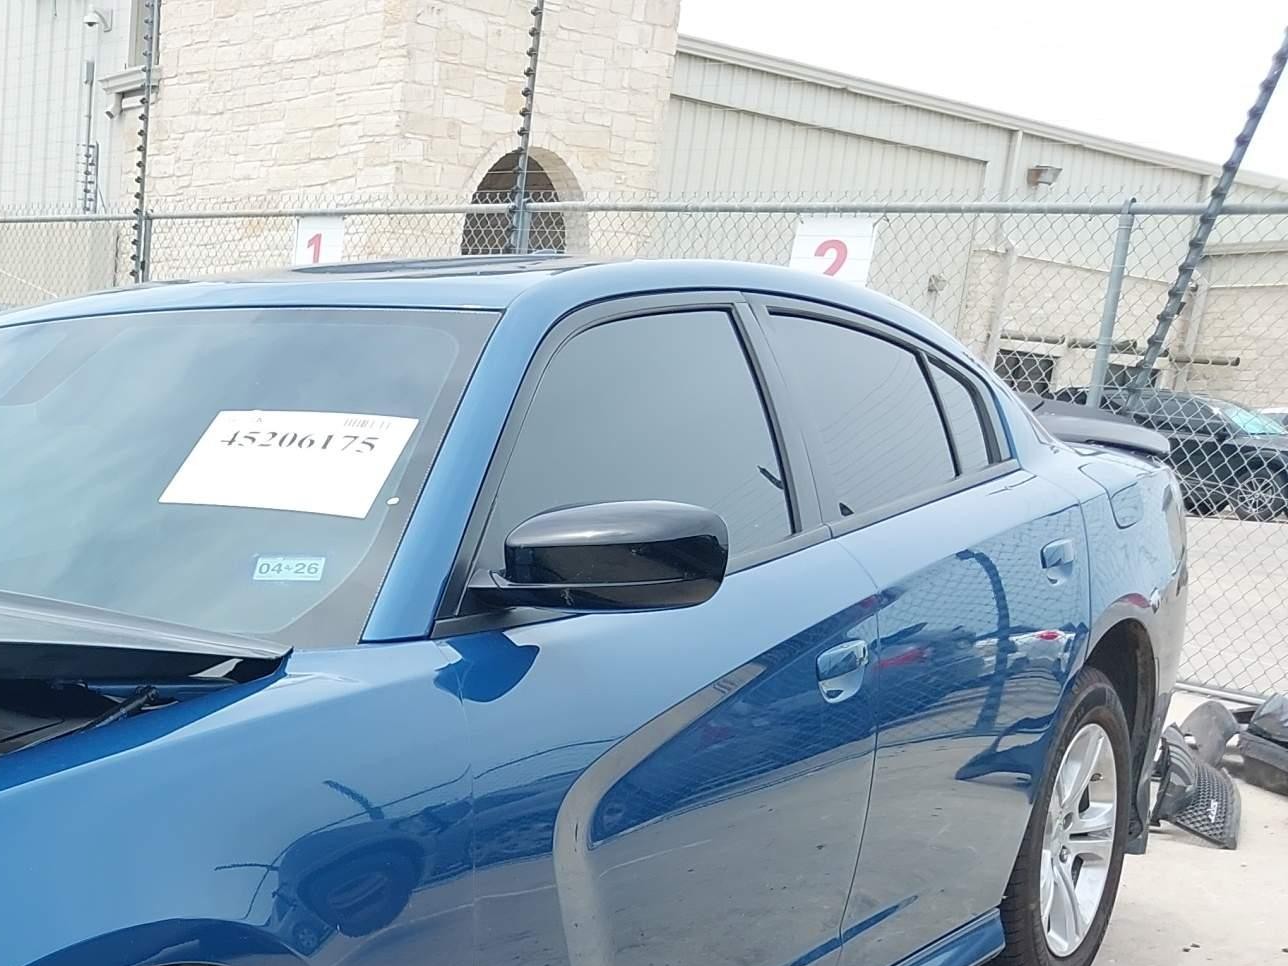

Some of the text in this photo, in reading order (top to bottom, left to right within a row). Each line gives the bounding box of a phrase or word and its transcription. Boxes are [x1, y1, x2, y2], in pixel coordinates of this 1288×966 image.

[307, 233, 322, 264] 1
[814, 239, 848, 277] 2
[220, 430, 380, 453] 45206175
